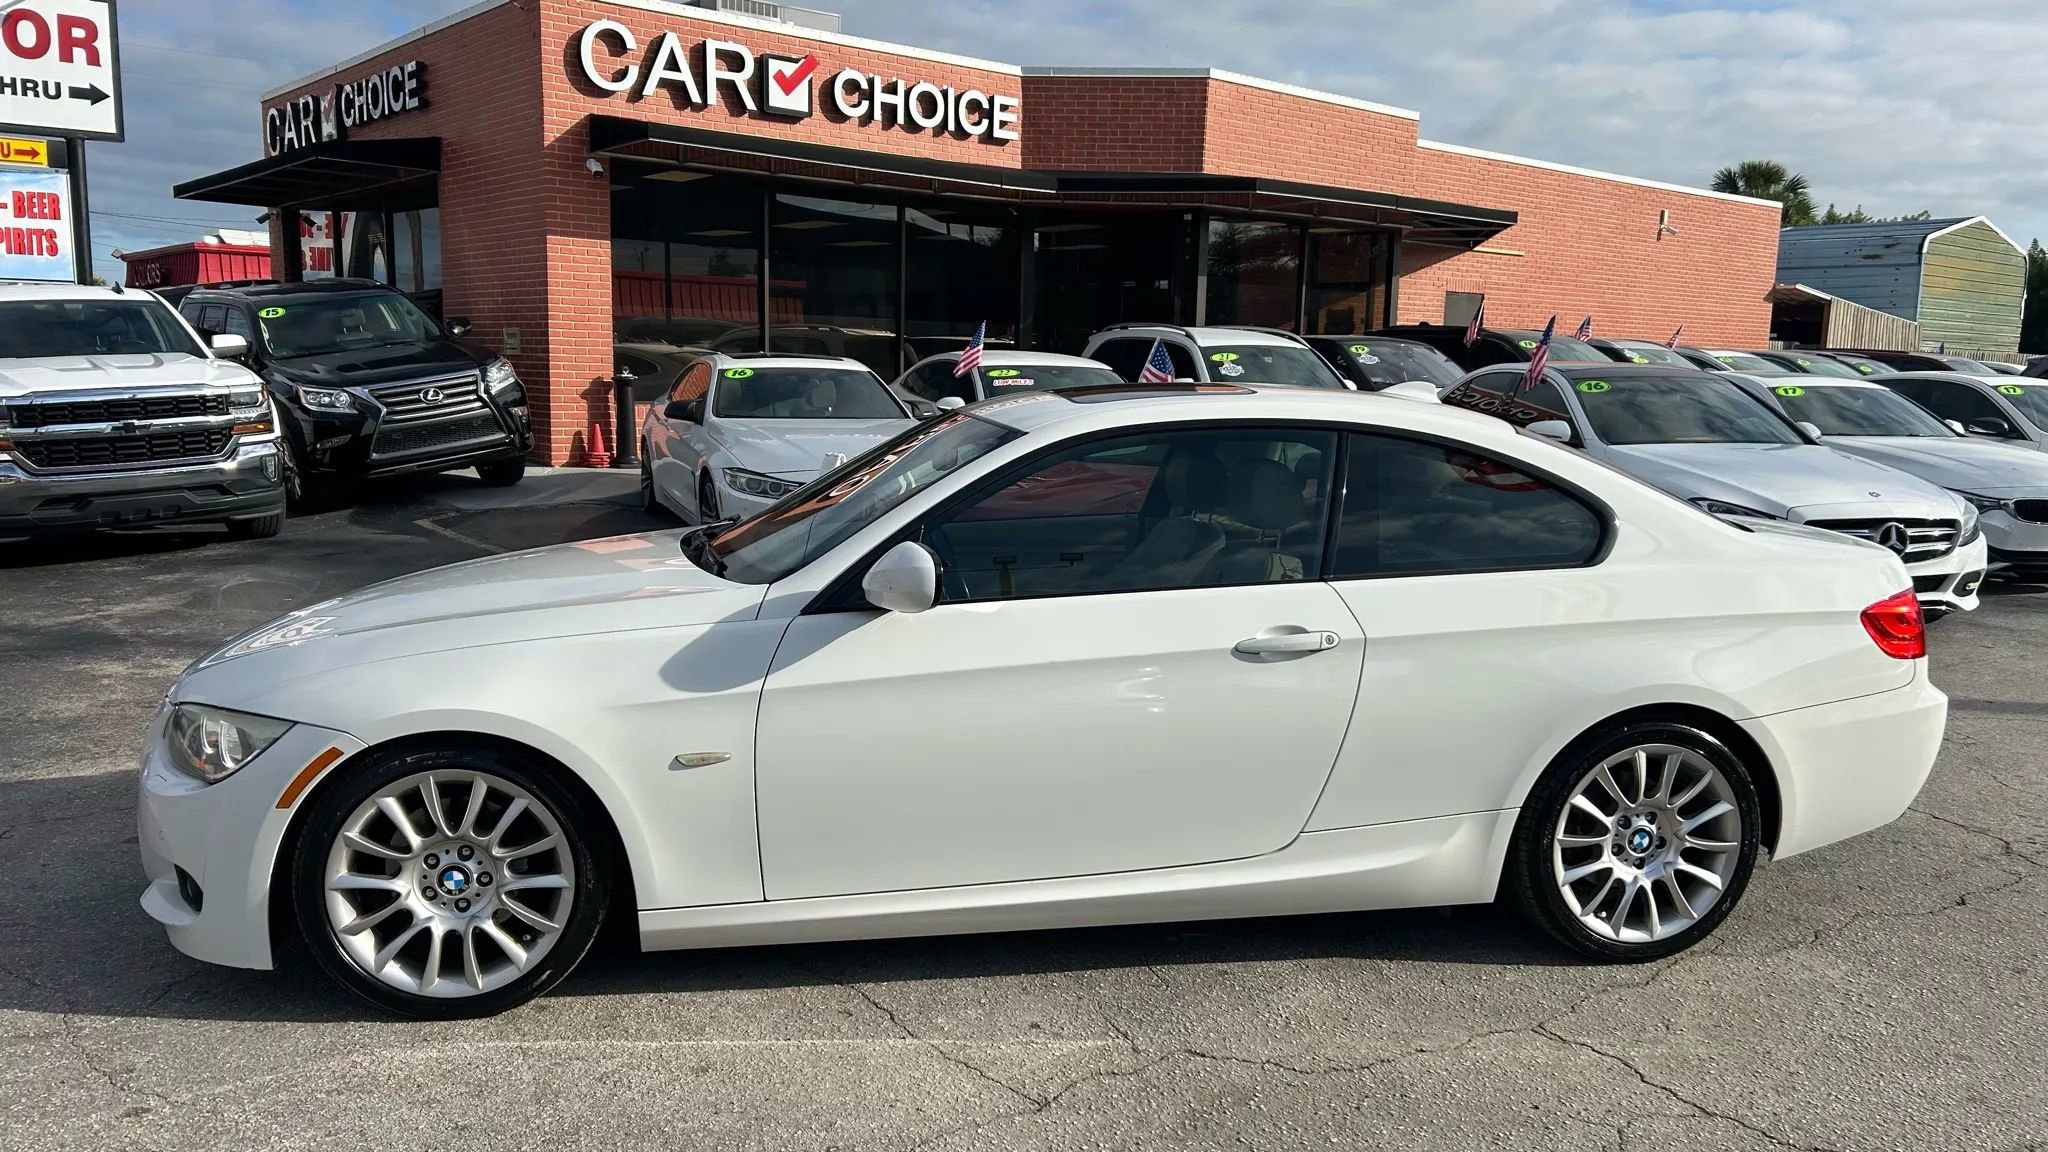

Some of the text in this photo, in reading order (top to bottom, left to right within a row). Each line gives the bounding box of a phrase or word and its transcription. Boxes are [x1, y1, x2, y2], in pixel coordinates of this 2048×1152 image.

[2, 8, 102, 67] OR
[0, 76, 61, 100] HRU
[580, 19, 1019, 141] CAR CHOICE
[266, 60, 420, 157] CAR CHOICE
[12, 191, 61, 220] BEER
[265, 309, 279, 317] 15
[1219, 353, 1230, 361] 21
[731, 369, 747, 377] 16
[1585, 382, 1605, 391] 16
[1782, 387, 1797, 395] 17
